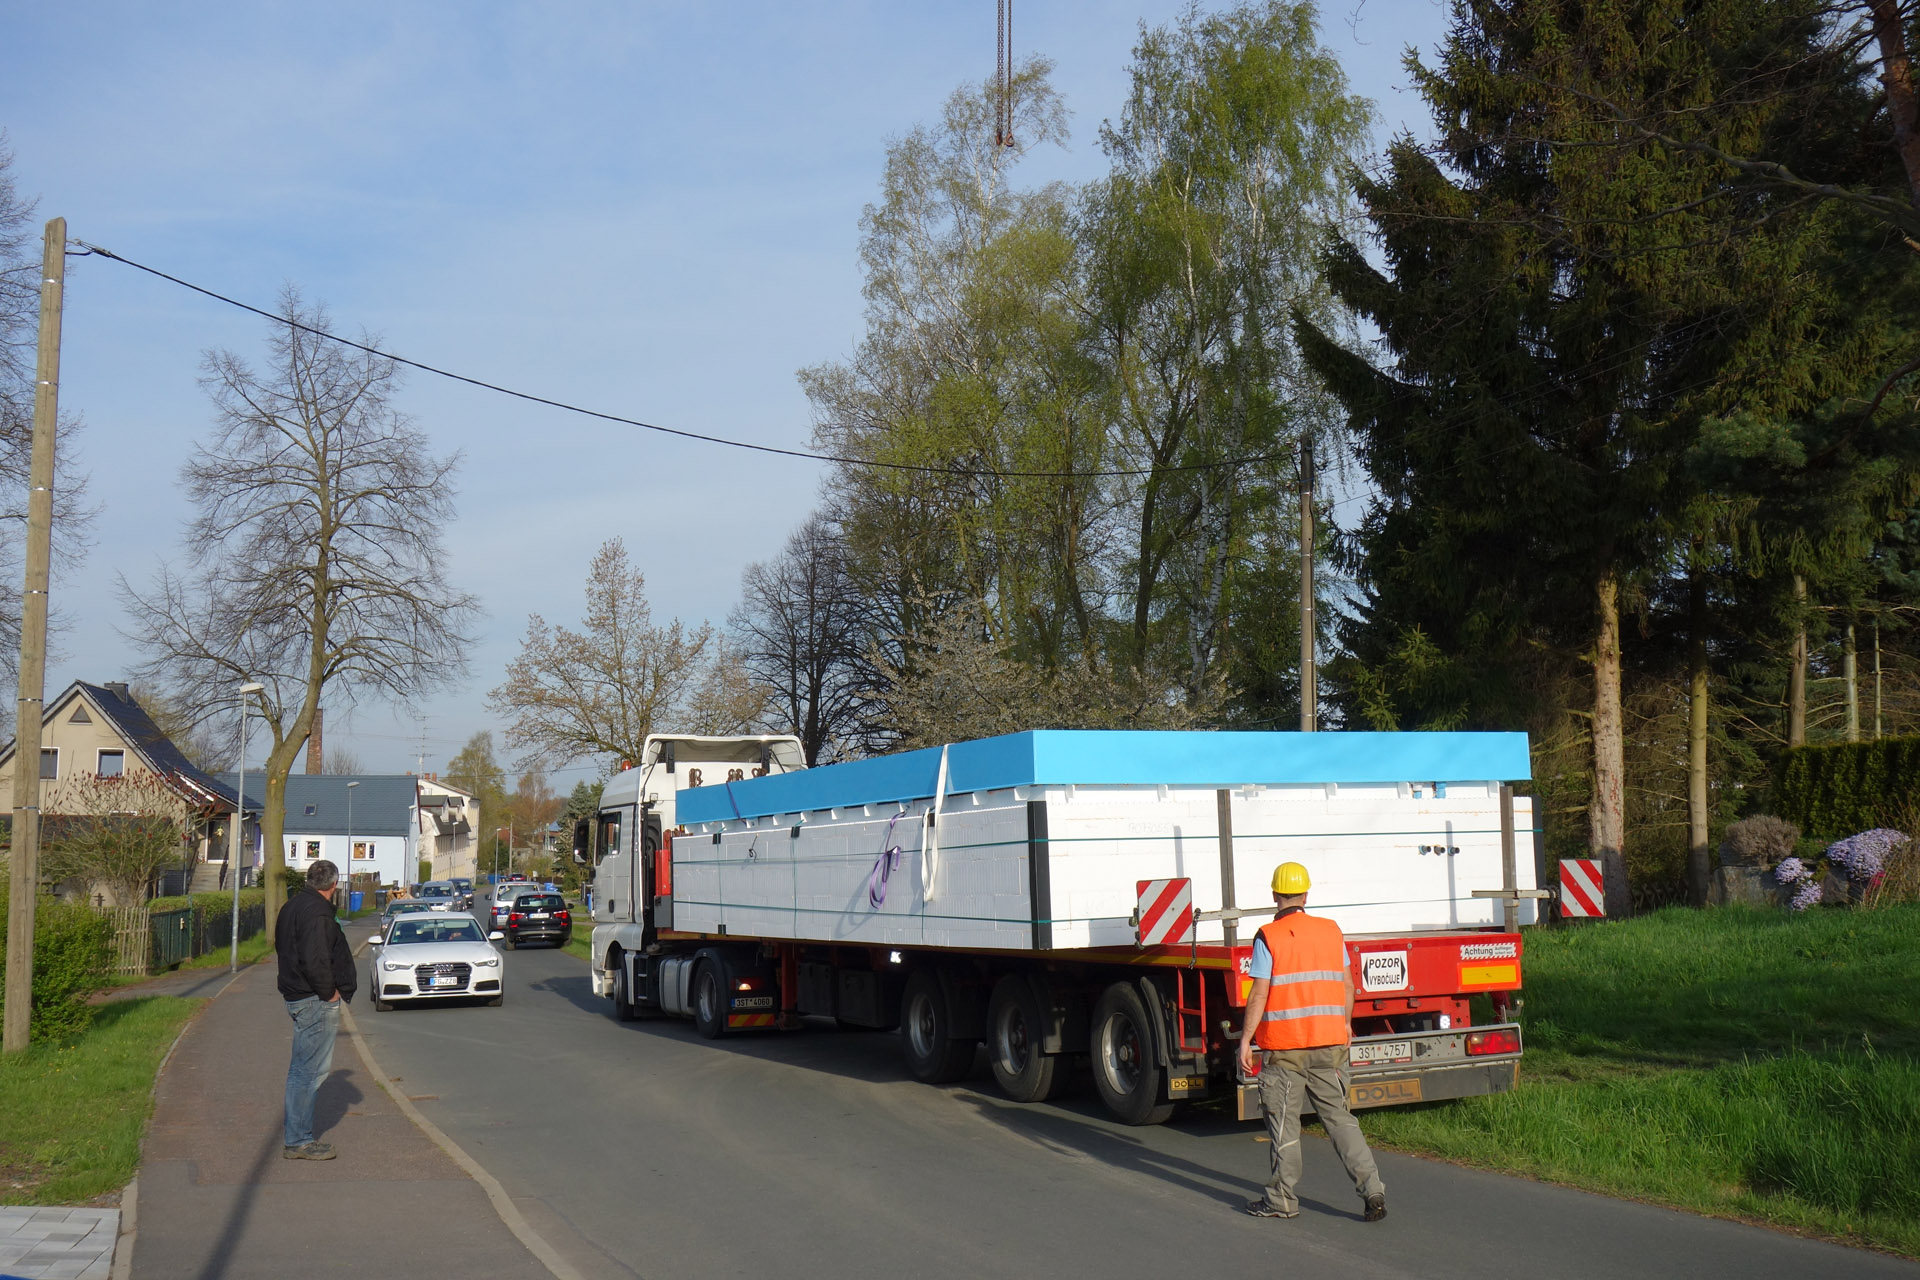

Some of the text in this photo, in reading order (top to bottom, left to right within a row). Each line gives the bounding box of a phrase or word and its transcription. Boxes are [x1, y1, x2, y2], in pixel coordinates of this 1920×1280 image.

[1464, 947, 1494, 956] Achtung
[1369, 957, 1400, 969] POZOR
[1383, 1043, 1406, 1057] 4757
[1174, 1079, 1202, 1088] DOLL
[1356, 1083, 1413, 1102] DOLL
